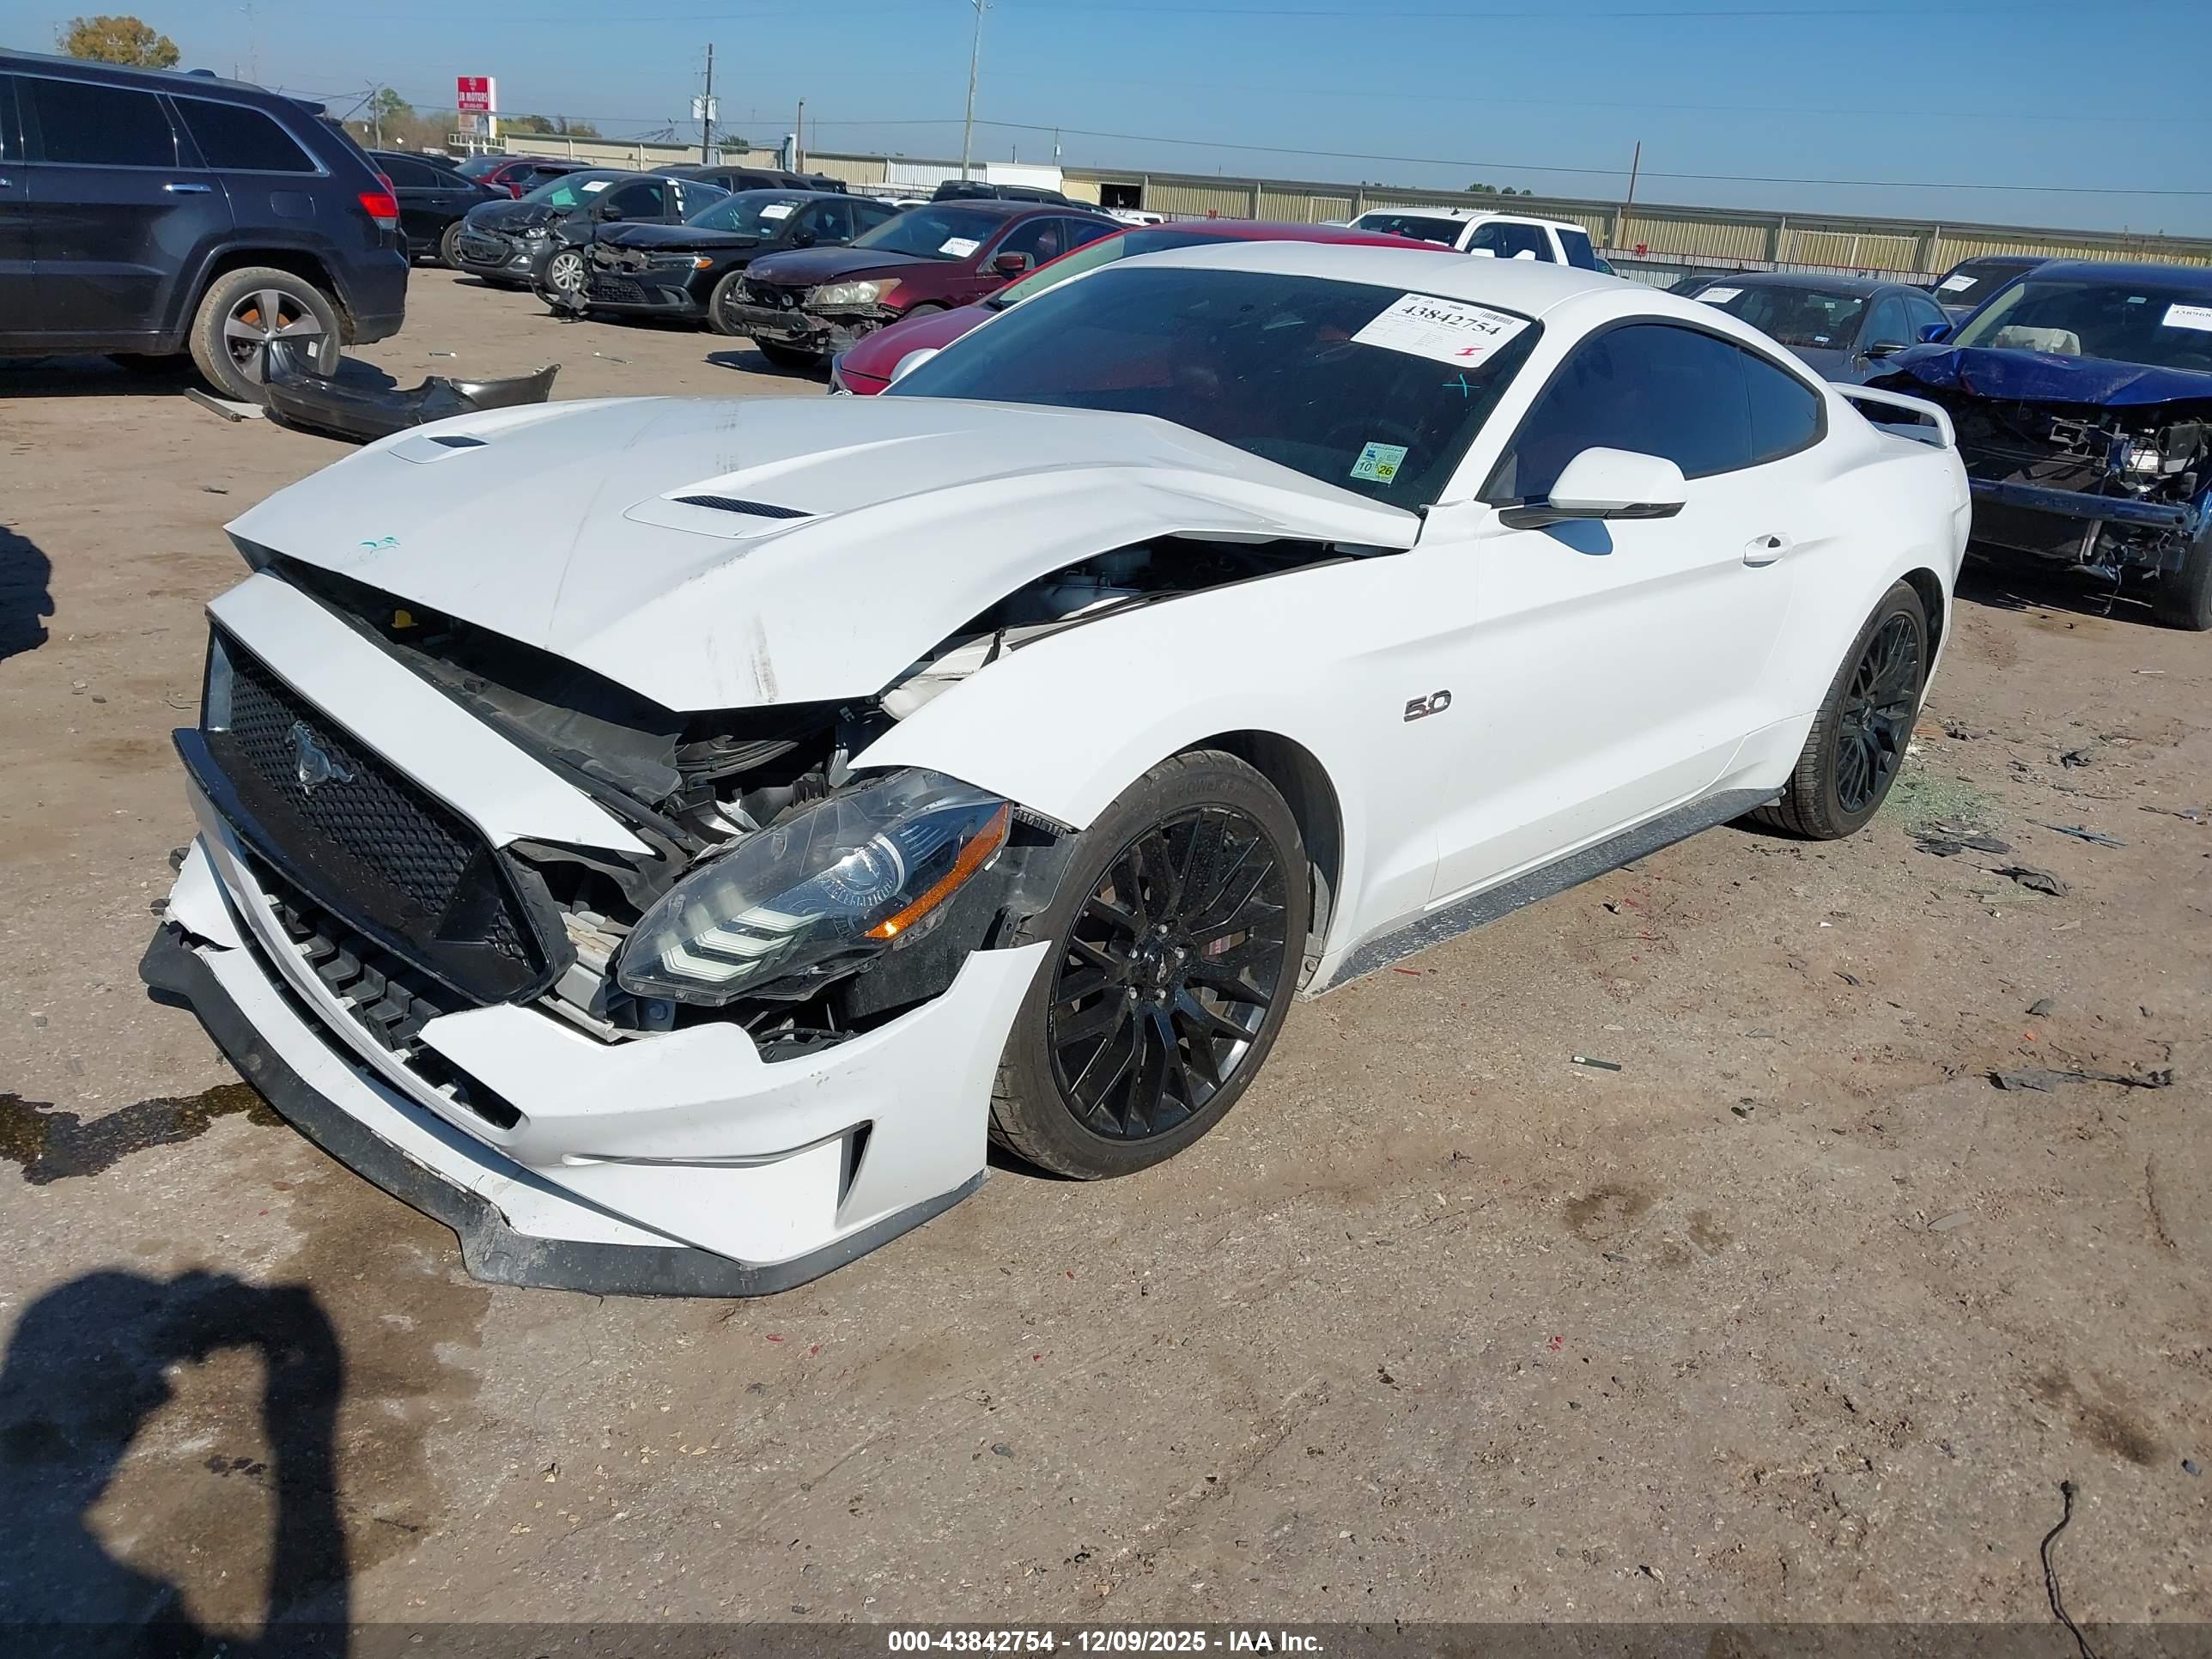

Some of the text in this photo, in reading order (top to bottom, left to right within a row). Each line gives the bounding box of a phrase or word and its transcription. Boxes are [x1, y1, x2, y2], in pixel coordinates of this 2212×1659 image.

[466, 92, 487, 102] MOTORS
[1401, 305, 1502, 336] 43842754
[1359, 462, 1394, 476] 10 26
[1403, 690, 1451, 722] 5.0
